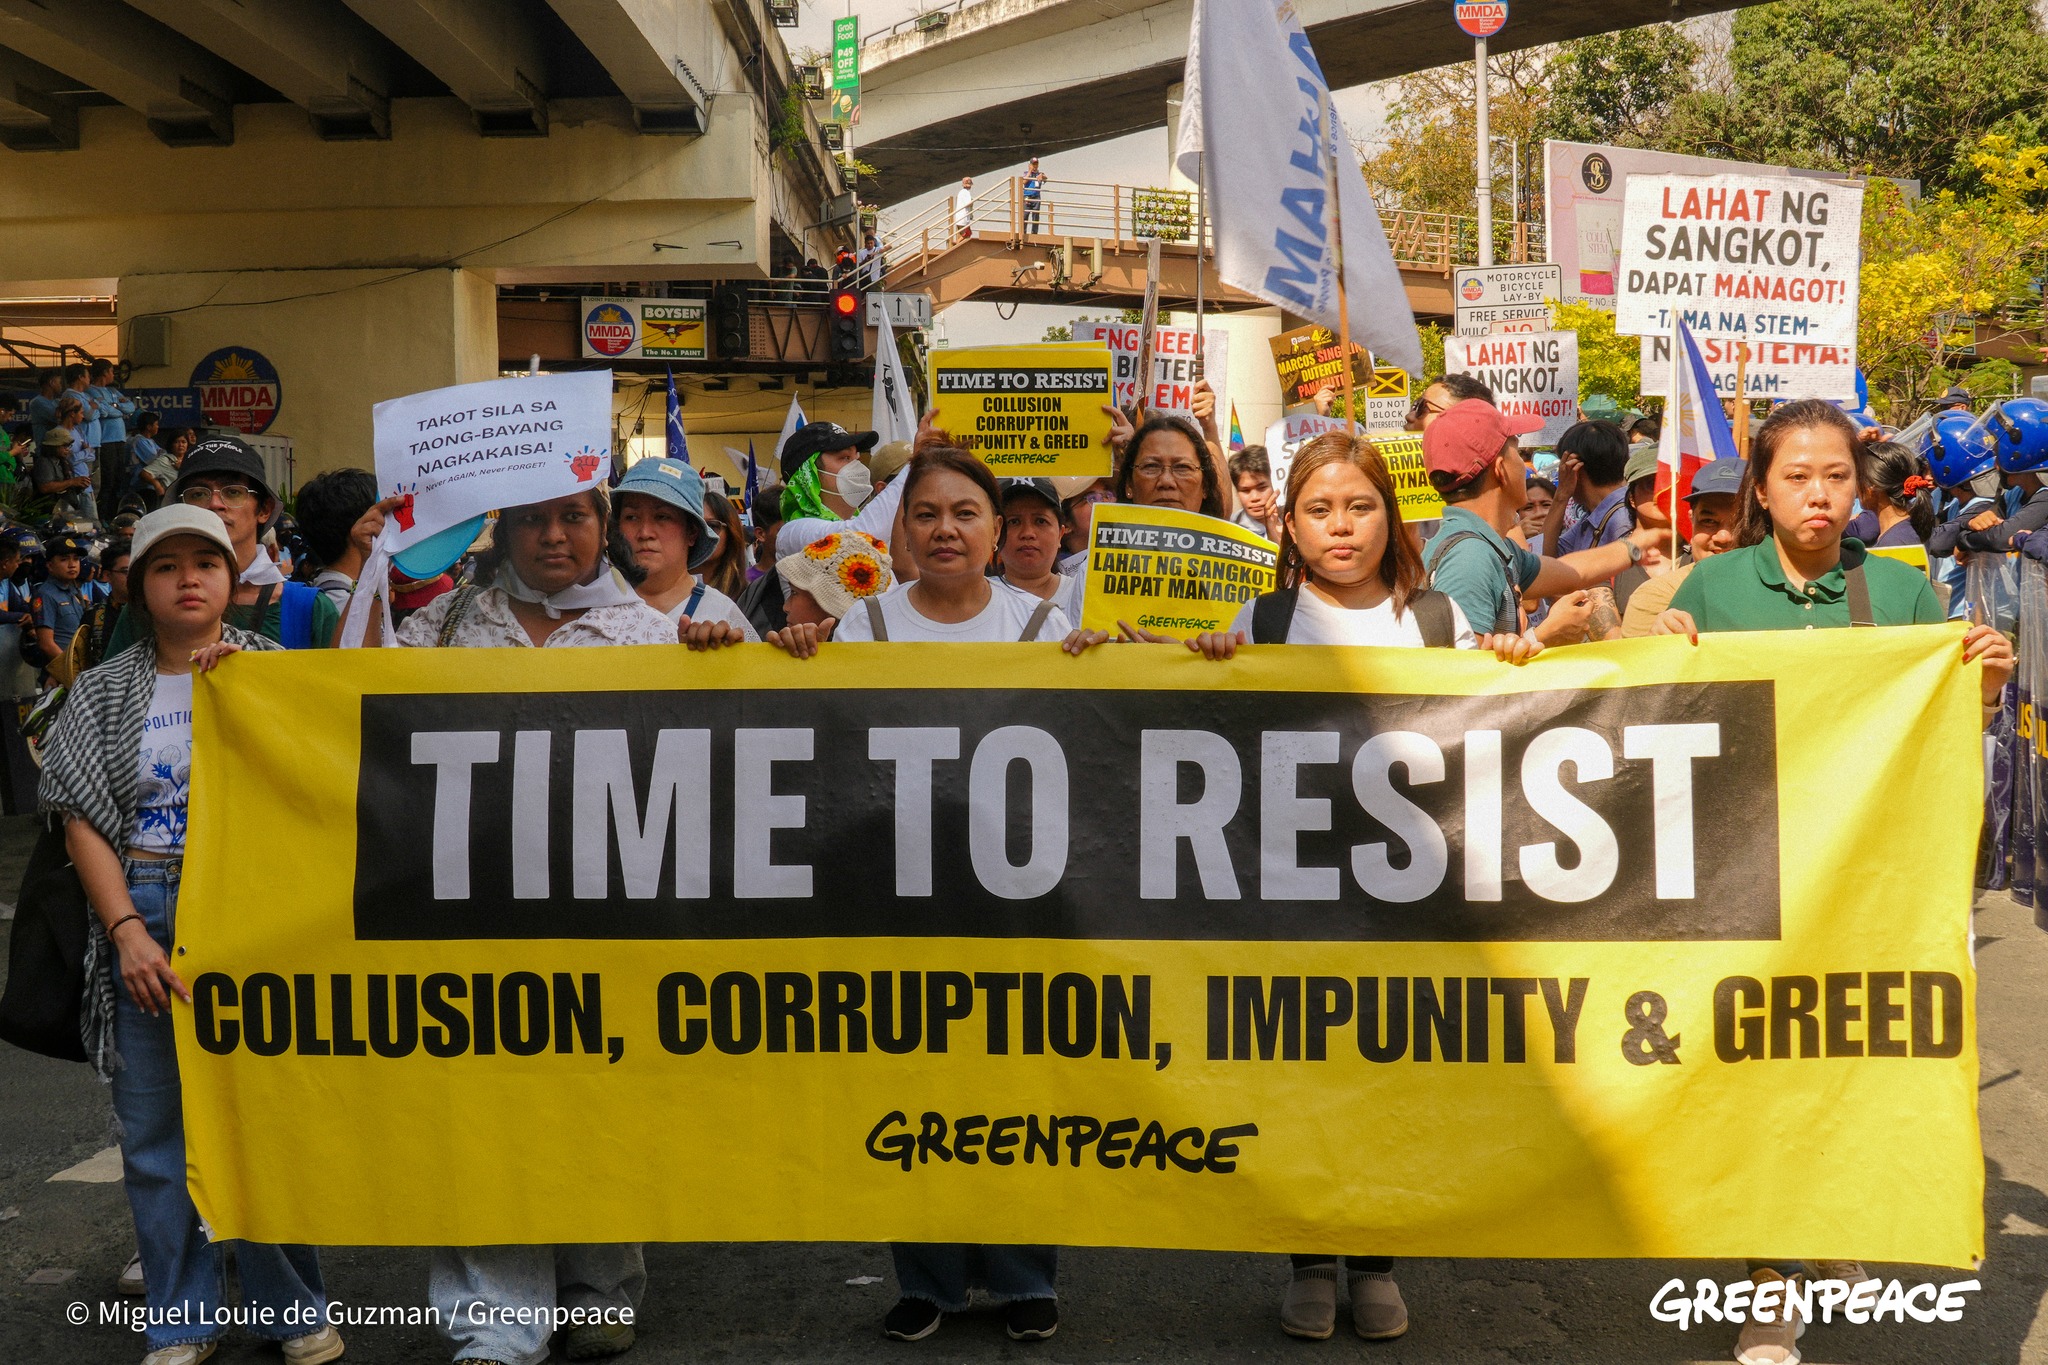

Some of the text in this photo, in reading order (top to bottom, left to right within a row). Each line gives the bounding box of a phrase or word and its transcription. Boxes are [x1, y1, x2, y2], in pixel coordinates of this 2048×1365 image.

[1459, 5, 1504, 18] MMDA
[838, 22, 854, 33] Grab
[838, 31, 854, 41] Food
[838, 47, 854, 58] P49
[838, 58, 854, 68] OFF
[1662, 186, 1829, 226] LAHAT NG
[1588, 244, 1608, 254] STEM
[1645, 224, 1831, 272] SANGKOT,
[1487, 270, 1557, 282] MOTORCYCLE
[1500, 282, 1544, 292] BICYCLE
[1628, 269, 1707, 296] DAPAT
[1714, 273, 1845, 304] MANAGOT!
[1503, 292, 1541, 302] LAY-BY
[645, 308, 701, 320] BOYSEN
[1470, 309, 1549, 322] FREE SERVICE
[1648, 310, 1711, 331] -TMA
[1718, 311, 1746, 332] NA
[589, 325, 631, 337] MMDA
[1466, 340, 1559, 366] LAHAT NG
[1278, 353, 1316, 375] MARCOS
[1301, 360, 1344, 382] DUTERTE
[938, 373, 1107, 389] TIME TO RESIST
[1462, 367, 1564, 395] ANGKOT,
[201, 386, 274, 408] MMDA
[983, 397, 1061, 412] COLLUSION
[1370, 400, 1406, 409] DO NOT
[416, 400, 557, 432] TAKOT SILA SA
[1502, 400, 1572, 417] MANAGOT!
[976, 416, 1069, 431] CORRUPTION
[409, 420, 564, 456] TAONG-BAYANG
[957, 434, 1088, 450] IMPUNITY & GREED
[219, 443, 243, 454] PEOPLE
[417, 441, 553, 478] NAGKAKAISA!
[984, 453, 1060, 465] GREENPEACE
[426, 461, 546, 493] Never AGAIN, Never FORGET!
[1098, 528, 1276, 566] TIME TO RESIST
[1093, 553, 1152, 574] LAHAT
[1156, 556, 1182, 576] NG
[1187, 559, 1275, 588] SANGKOT
[1103, 575, 1164, 596] DAPAT
[1138, 614, 1220, 630] GREENPEACE
[411, 722, 1720, 904] TIME TO RESIST
[195, 970, 1964, 1072] COLLUSION, CORRUPTION, IMPUNITY & GREED
[866, 1110, 1259, 1174] GREENPEACE
